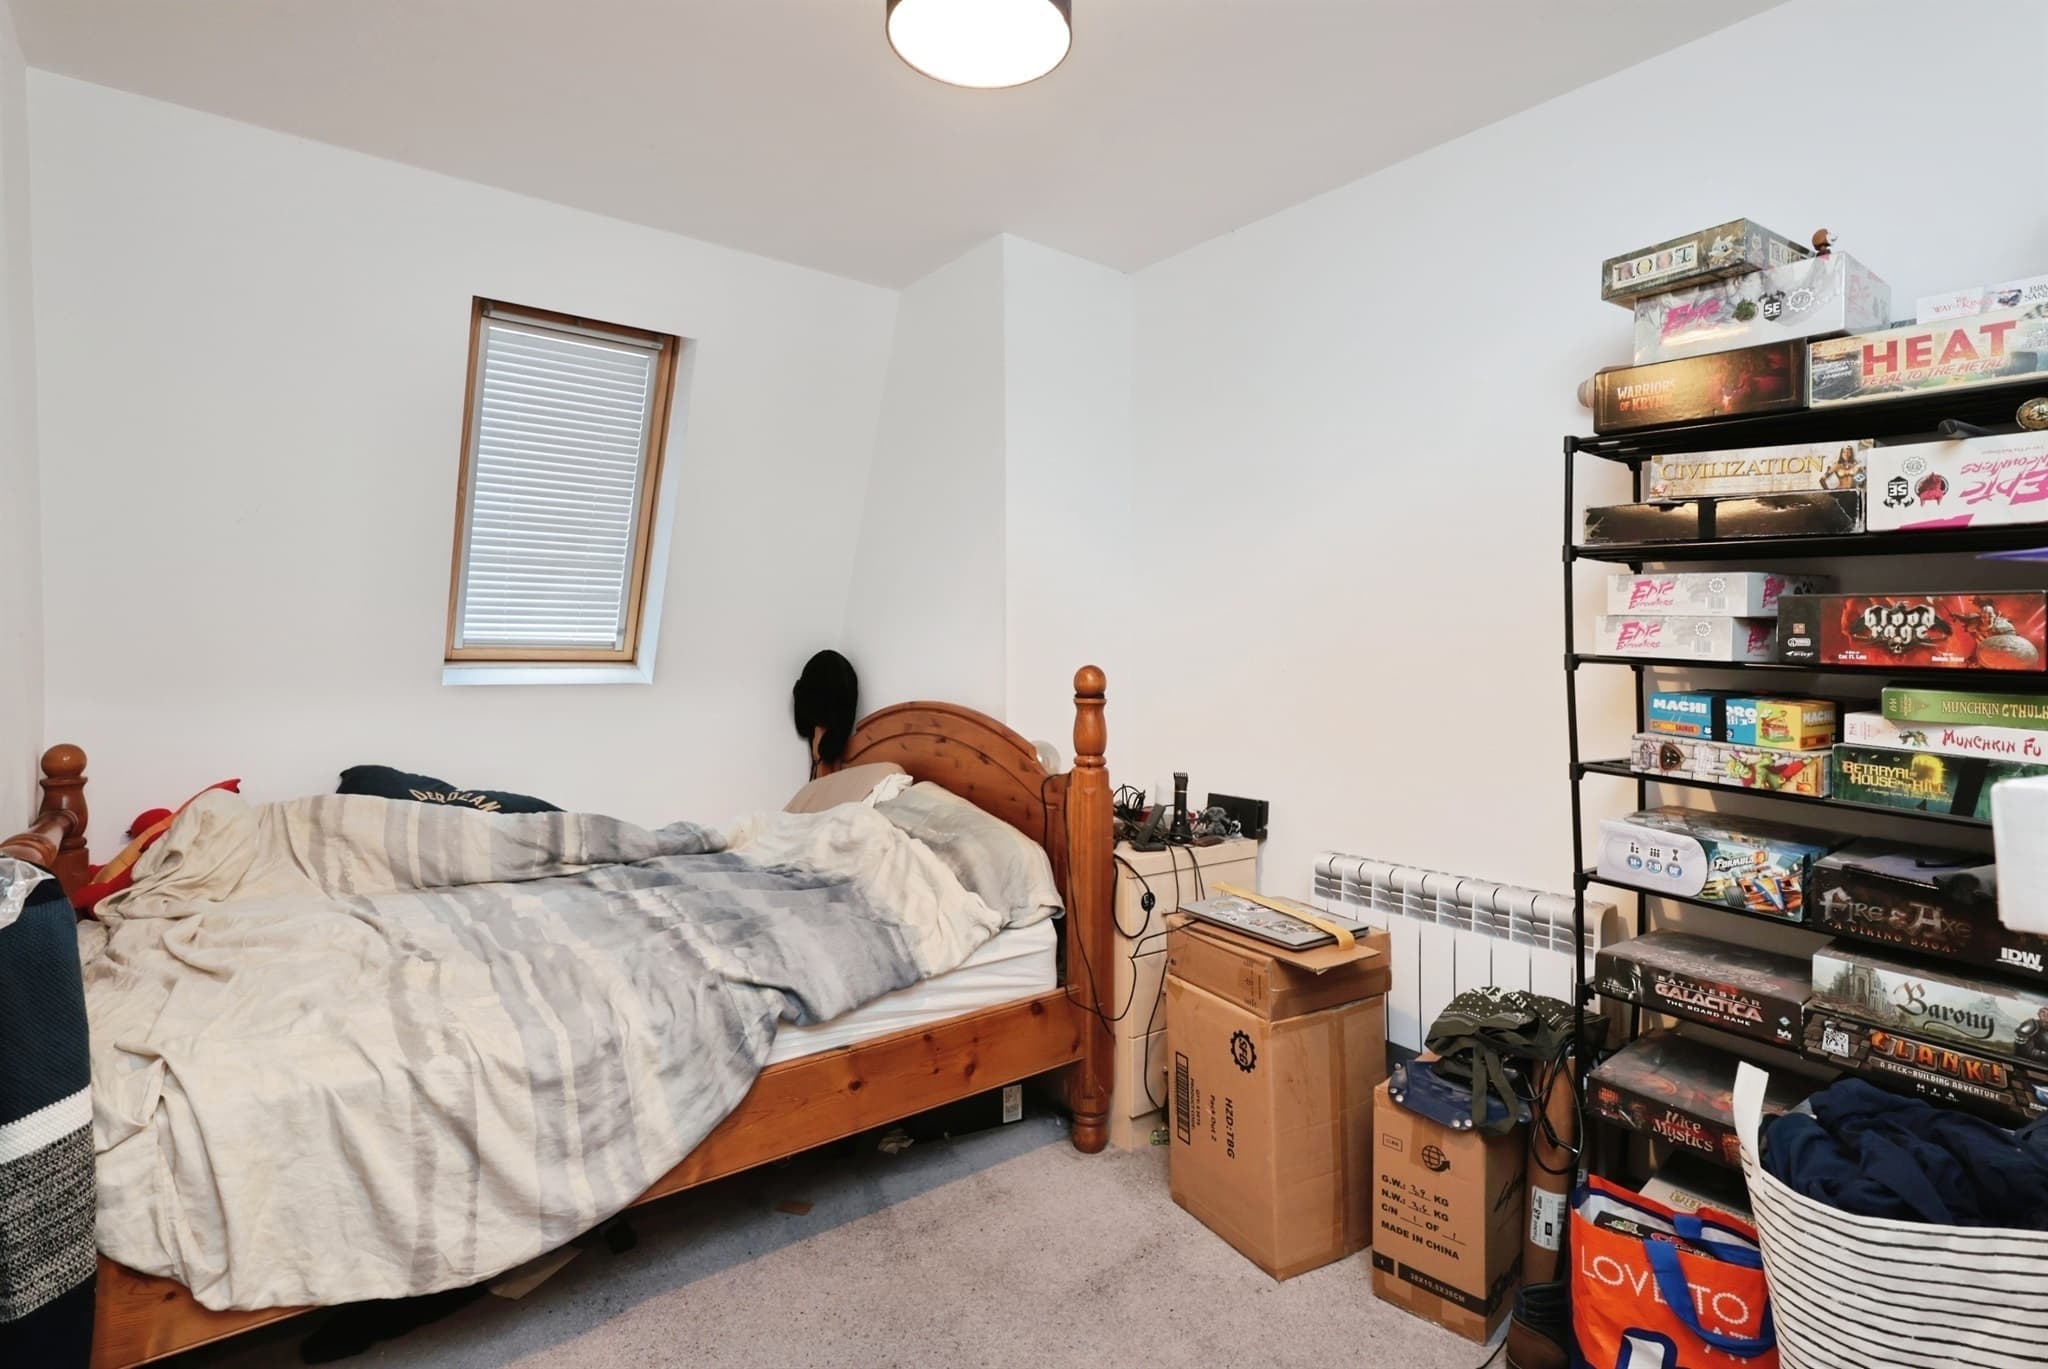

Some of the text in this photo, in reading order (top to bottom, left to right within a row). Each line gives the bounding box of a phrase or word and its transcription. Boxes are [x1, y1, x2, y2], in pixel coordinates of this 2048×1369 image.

[1862, 320, 2017, 376] HEAT
[1862, 359, 2005, 386] PEDAL TO THE METAL
[1616, 379, 1676, 400] WARRIORS
[1659, 456, 1827, 481] CIVILIZATION
[1864, 604, 1936, 627] blood
[1871, 623, 1930, 645] rage
[1653, 698, 1707, 714] MACHI
[1942, 701, 1999, 718] MUNCHKIN
[1842, 760, 1911, 780] BETRAYAL
[1850, 774, 1895, 788] HOUSE
[2000, 947, 2041, 967] IDW
[1654, 982, 1764, 1023] GALACTICA
[1658, 975, 1761, 1007] BATTLESTAR
[1666, 999, 1751, 1027] THE BOARD GAME
[1893, 982, 1996, 1039] Barony
[1238, 1036, 1249, 1065] SFG
[1871, 1031, 2004, 1083] CLANK!
[1887, 1064, 1950, 1087] DECK-BUILDING
[1952, 1081, 2000, 1101] ADVENTURE
[1225, 1097, 1235, 1159] HZD:TBG
[1665, 1110, 1702, 1134] Mice
[1652, 1119, 1714, 1152] Mystics
[1433, 1194, 1449, 1208] KG
[1425, 1221, 1440, 1233] OF
[1433, 1209, 1449, 1222] KG
[1381, 1220, 1460, 1261] MADE IN CHINA
[1686, 1282, 1749, 1325] TO
